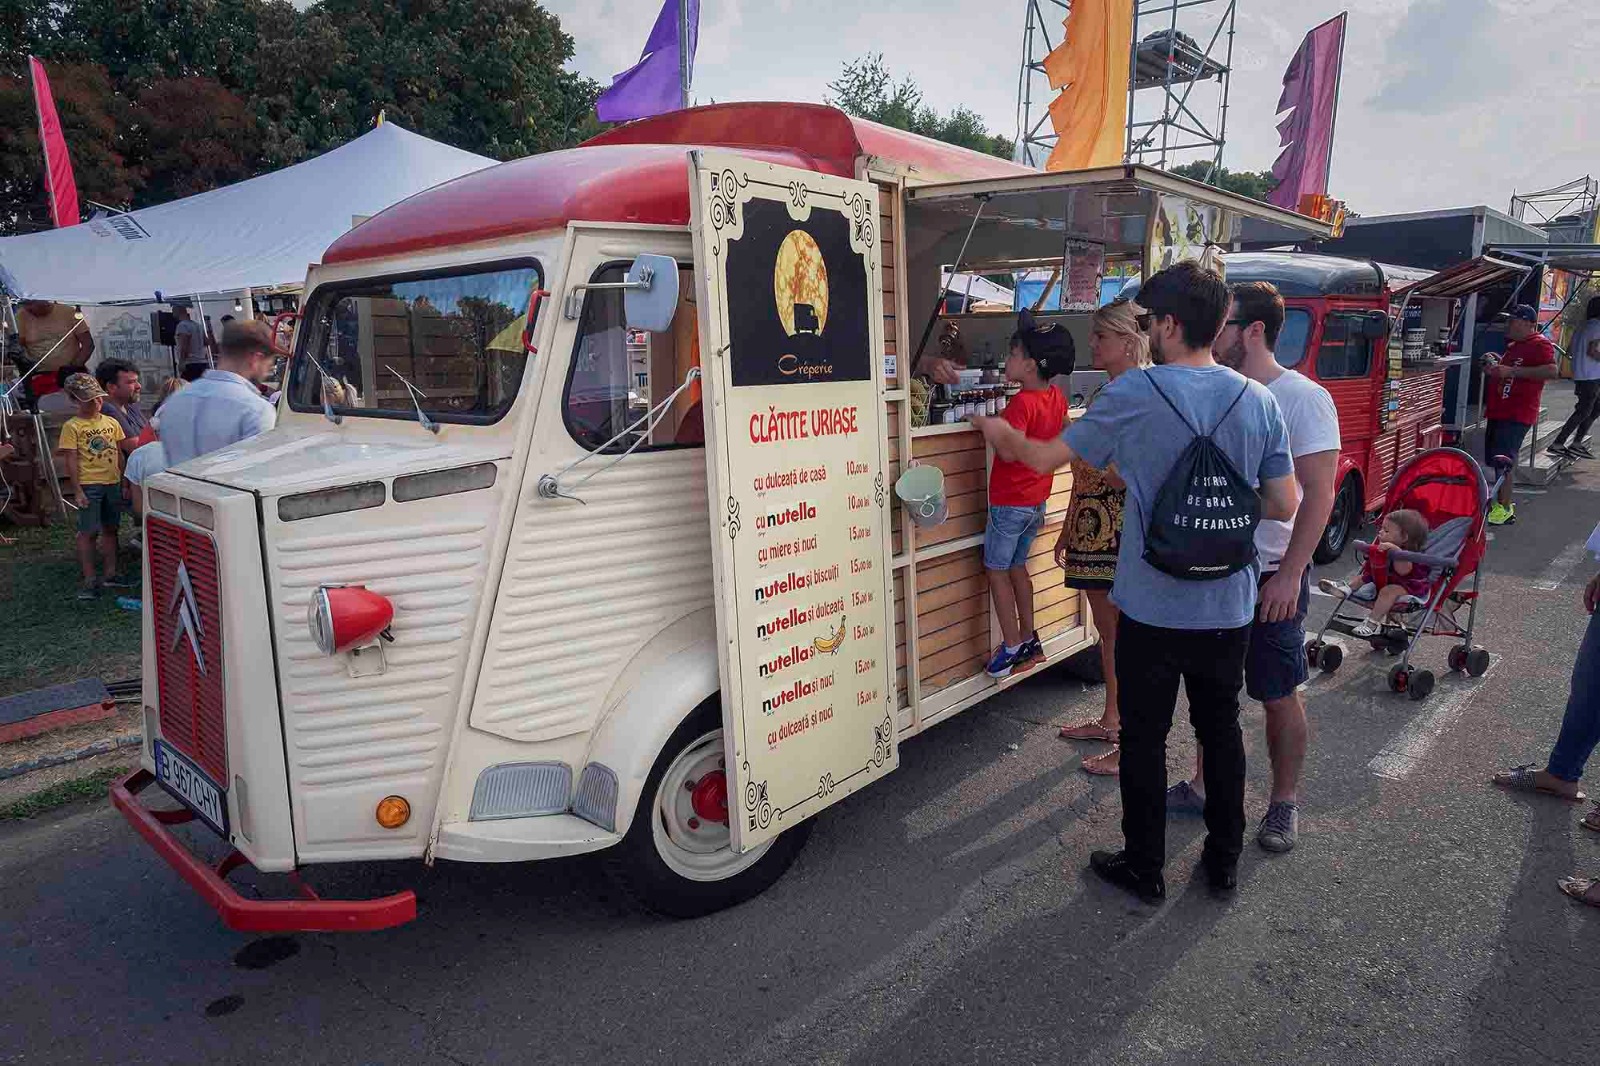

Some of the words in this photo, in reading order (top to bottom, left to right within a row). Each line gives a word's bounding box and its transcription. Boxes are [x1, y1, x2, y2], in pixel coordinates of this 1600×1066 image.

[749, 405, 809, 444] CLĂTITE
[811, 406, 858, 439] URIAȘE
[753, 477, 764, 492] cu
[765, 468, 798, 489] dulceață
[799, 467, 808, 484] de
[810, 464, 827, 482] casă
[755, 515, 766, 530] cu
[767, 501, 817, 528] nutella
[1187, 494, 1201, 507] BE
[1174, 513, 1188, 527] BE
[1194, 514, 1251, 530] FEARLESS
[758, 548, 768, 562] cu
[769, 542, 792, 560] miere
[802, 533, 818, 552] nuci
[755, 572, 805, 601] nutella
[757, 608, 807, 639] nutella
[759, 646, 809, 678] nutella
[762, 680, 811, 713] nutella
[820, 670, 835, 690] nuci
[767, 731, 777, 746] cu
[819, 703, 834, 723] nuci
[161, 751, 171, 781] B
[194, 776, 220, 822] CHY
